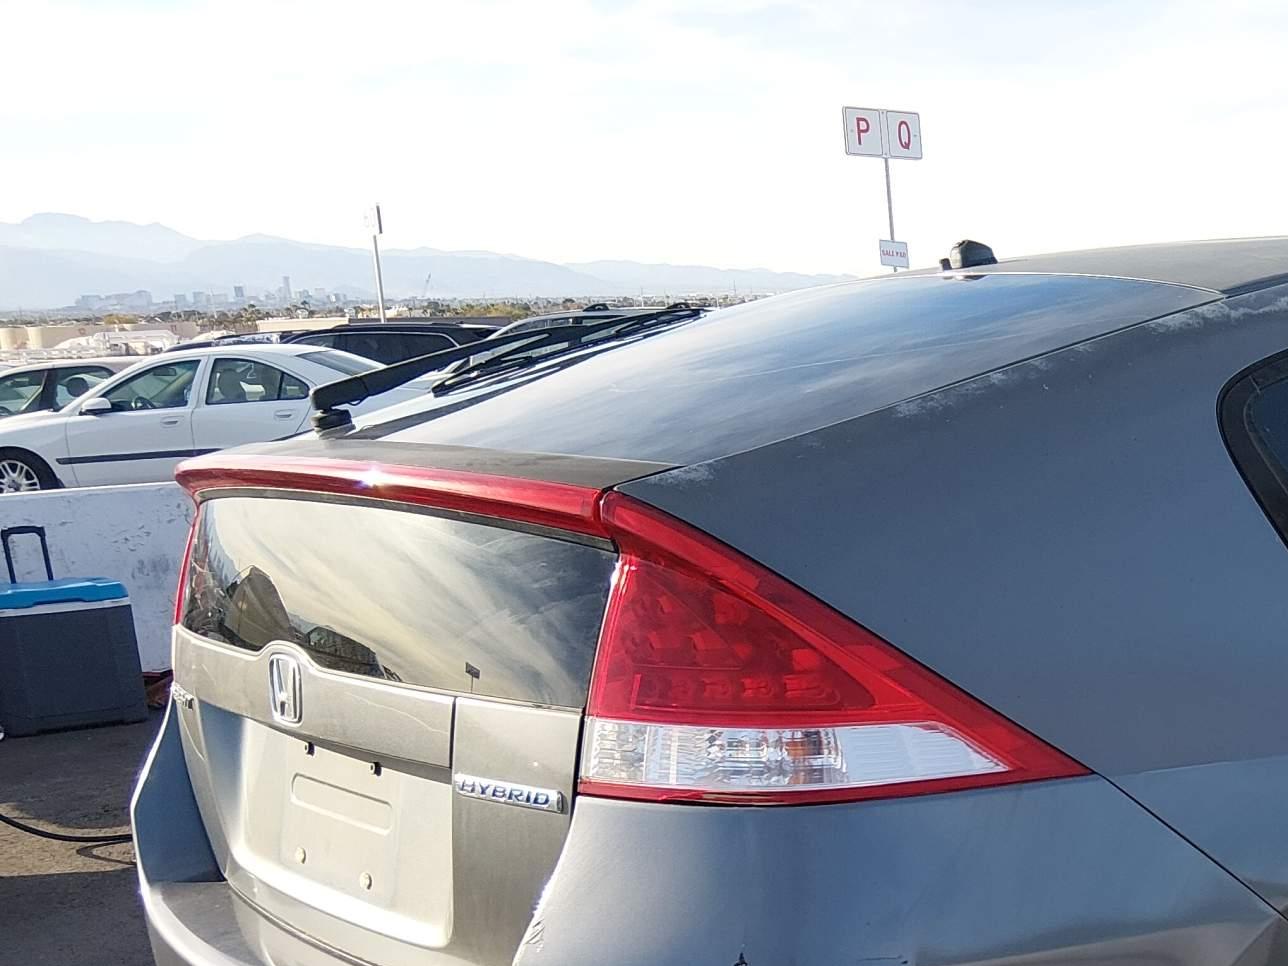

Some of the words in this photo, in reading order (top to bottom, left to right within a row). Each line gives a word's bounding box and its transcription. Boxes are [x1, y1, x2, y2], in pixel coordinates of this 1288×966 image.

[855, 116, 870, 146] P
[897, 120, 911, 150] Q
[459, 779, 551, 806] HYBRID
